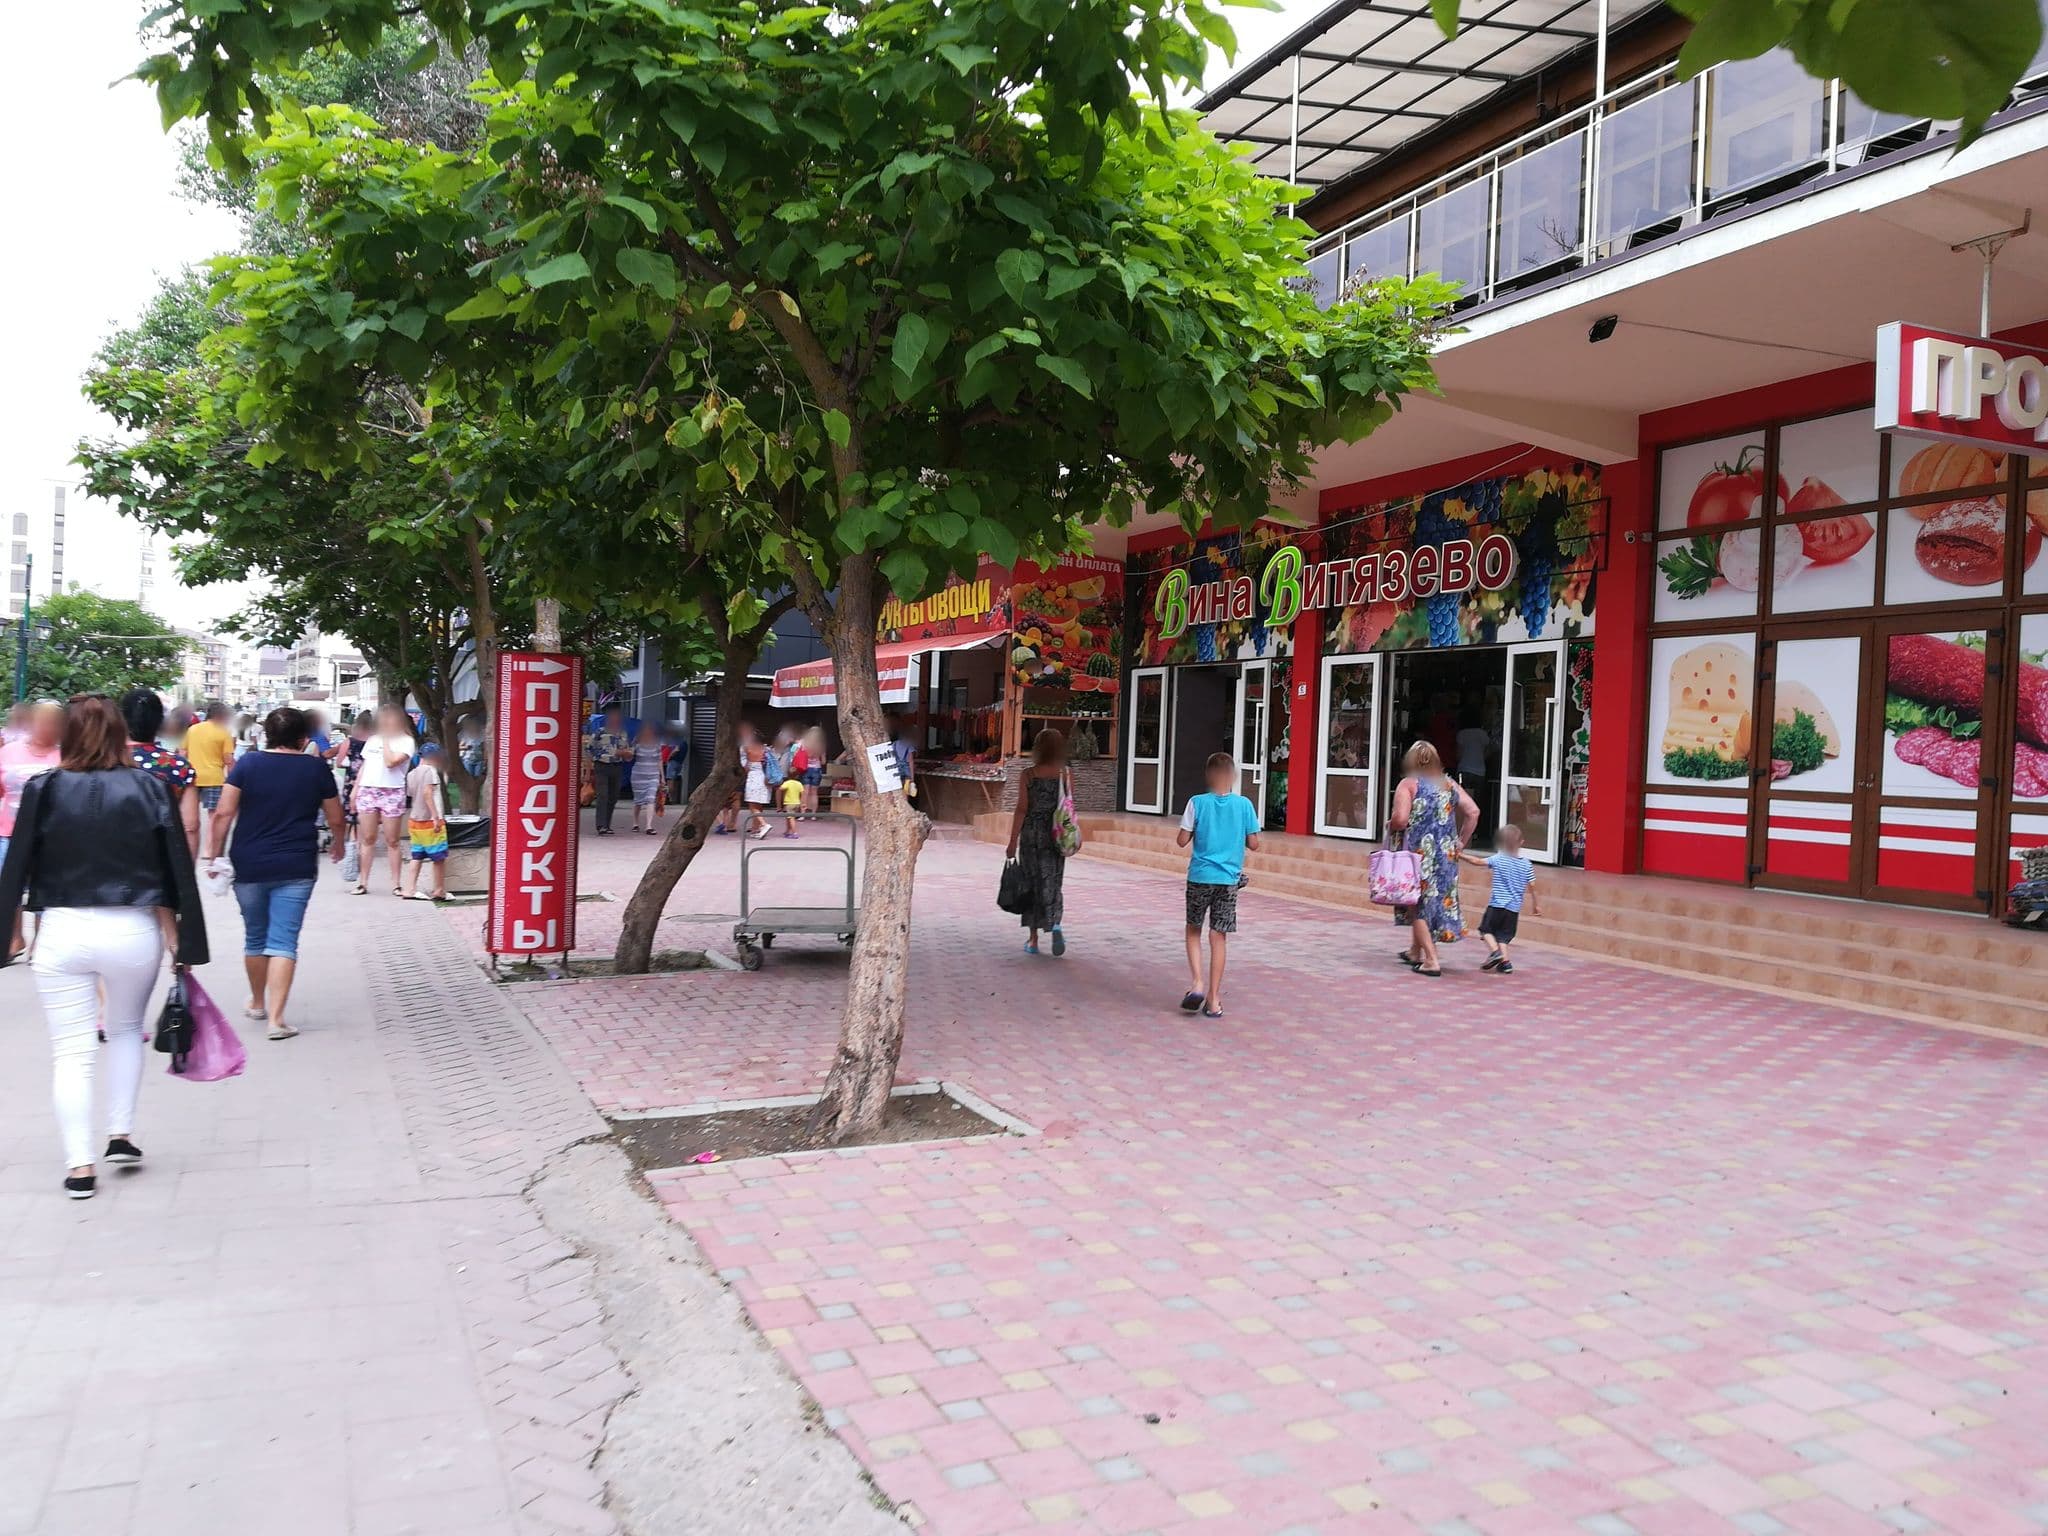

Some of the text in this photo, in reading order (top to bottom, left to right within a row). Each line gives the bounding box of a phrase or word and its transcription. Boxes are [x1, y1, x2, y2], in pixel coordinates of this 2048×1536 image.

[1911, 337, 2048, 442] ПРО
[877, 578, 991, 632] РУКТЫ ОВОЩИ
[511, 682, 561, 949] ПРОДУКТЫ
